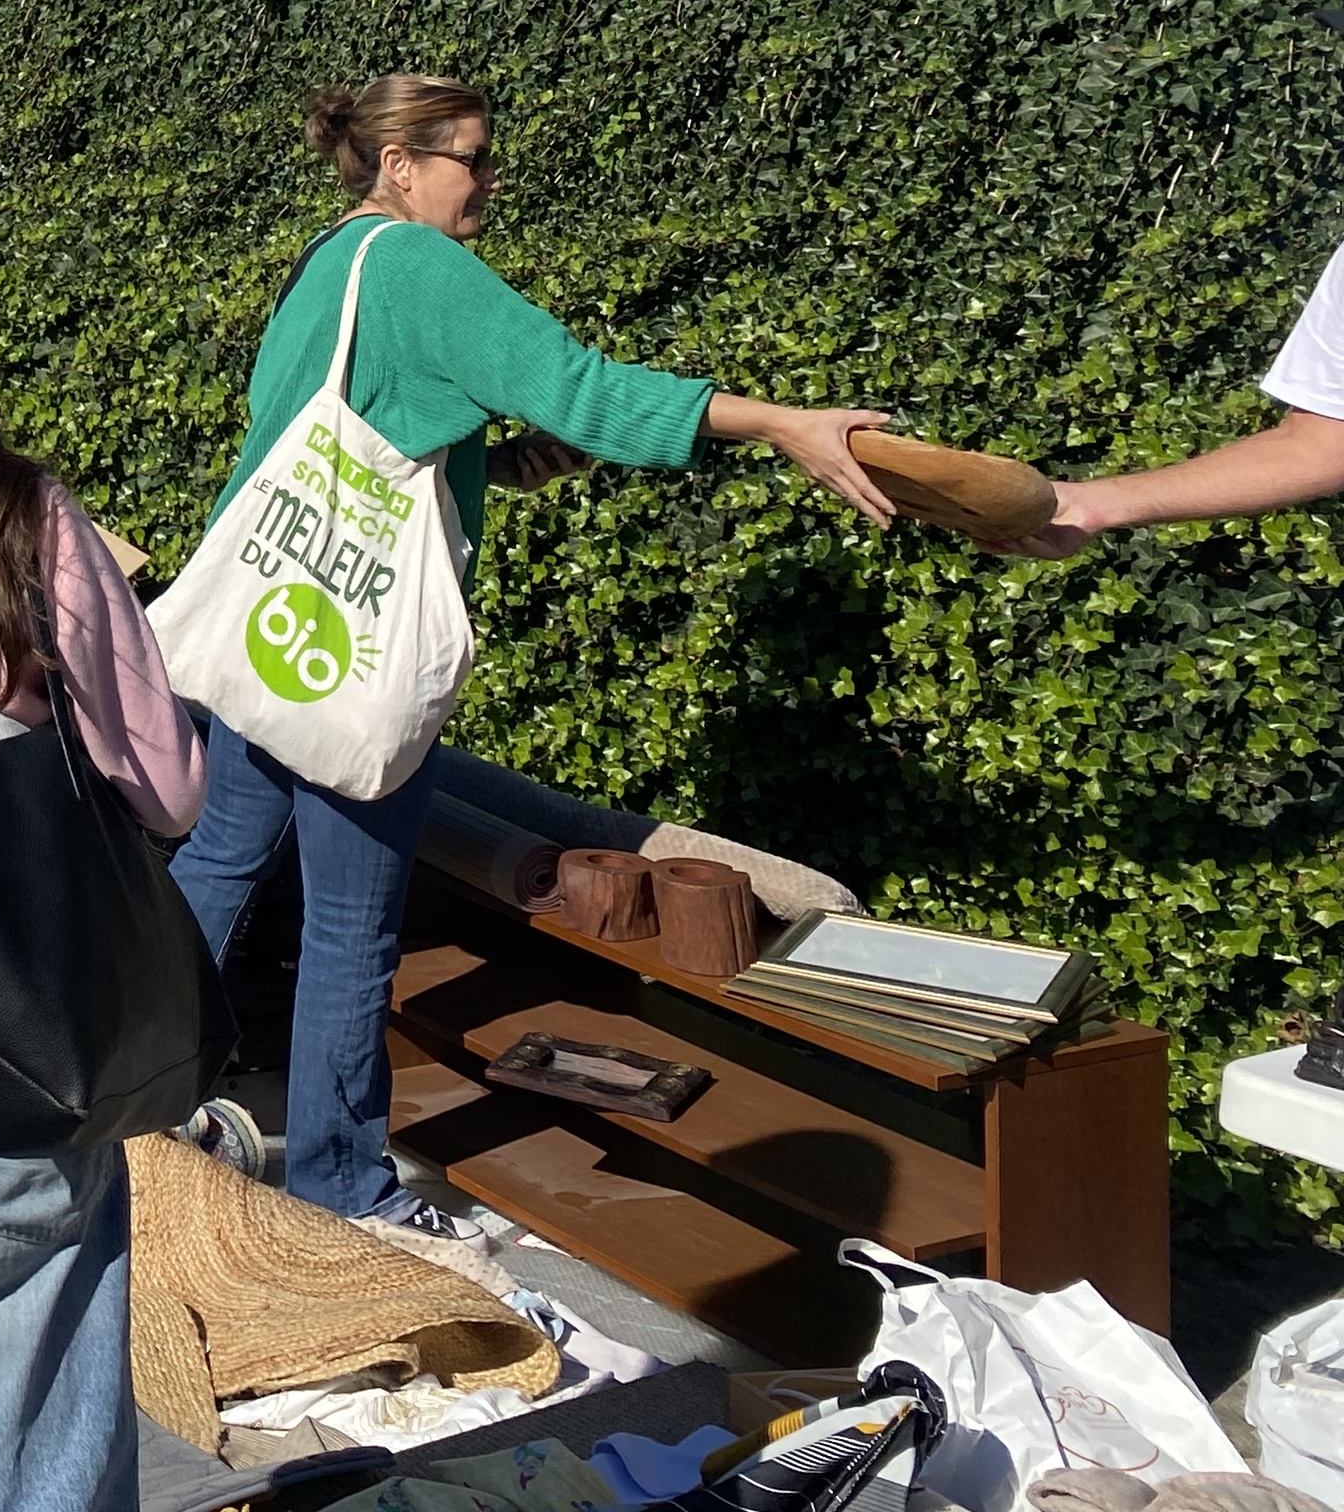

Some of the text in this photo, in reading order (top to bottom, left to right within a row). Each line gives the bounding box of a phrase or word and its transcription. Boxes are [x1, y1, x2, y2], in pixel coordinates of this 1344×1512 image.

[253, 476, 273, 495] LE
[239, 538, 282, 579] DU
[257, 586, 340, 692] bio
